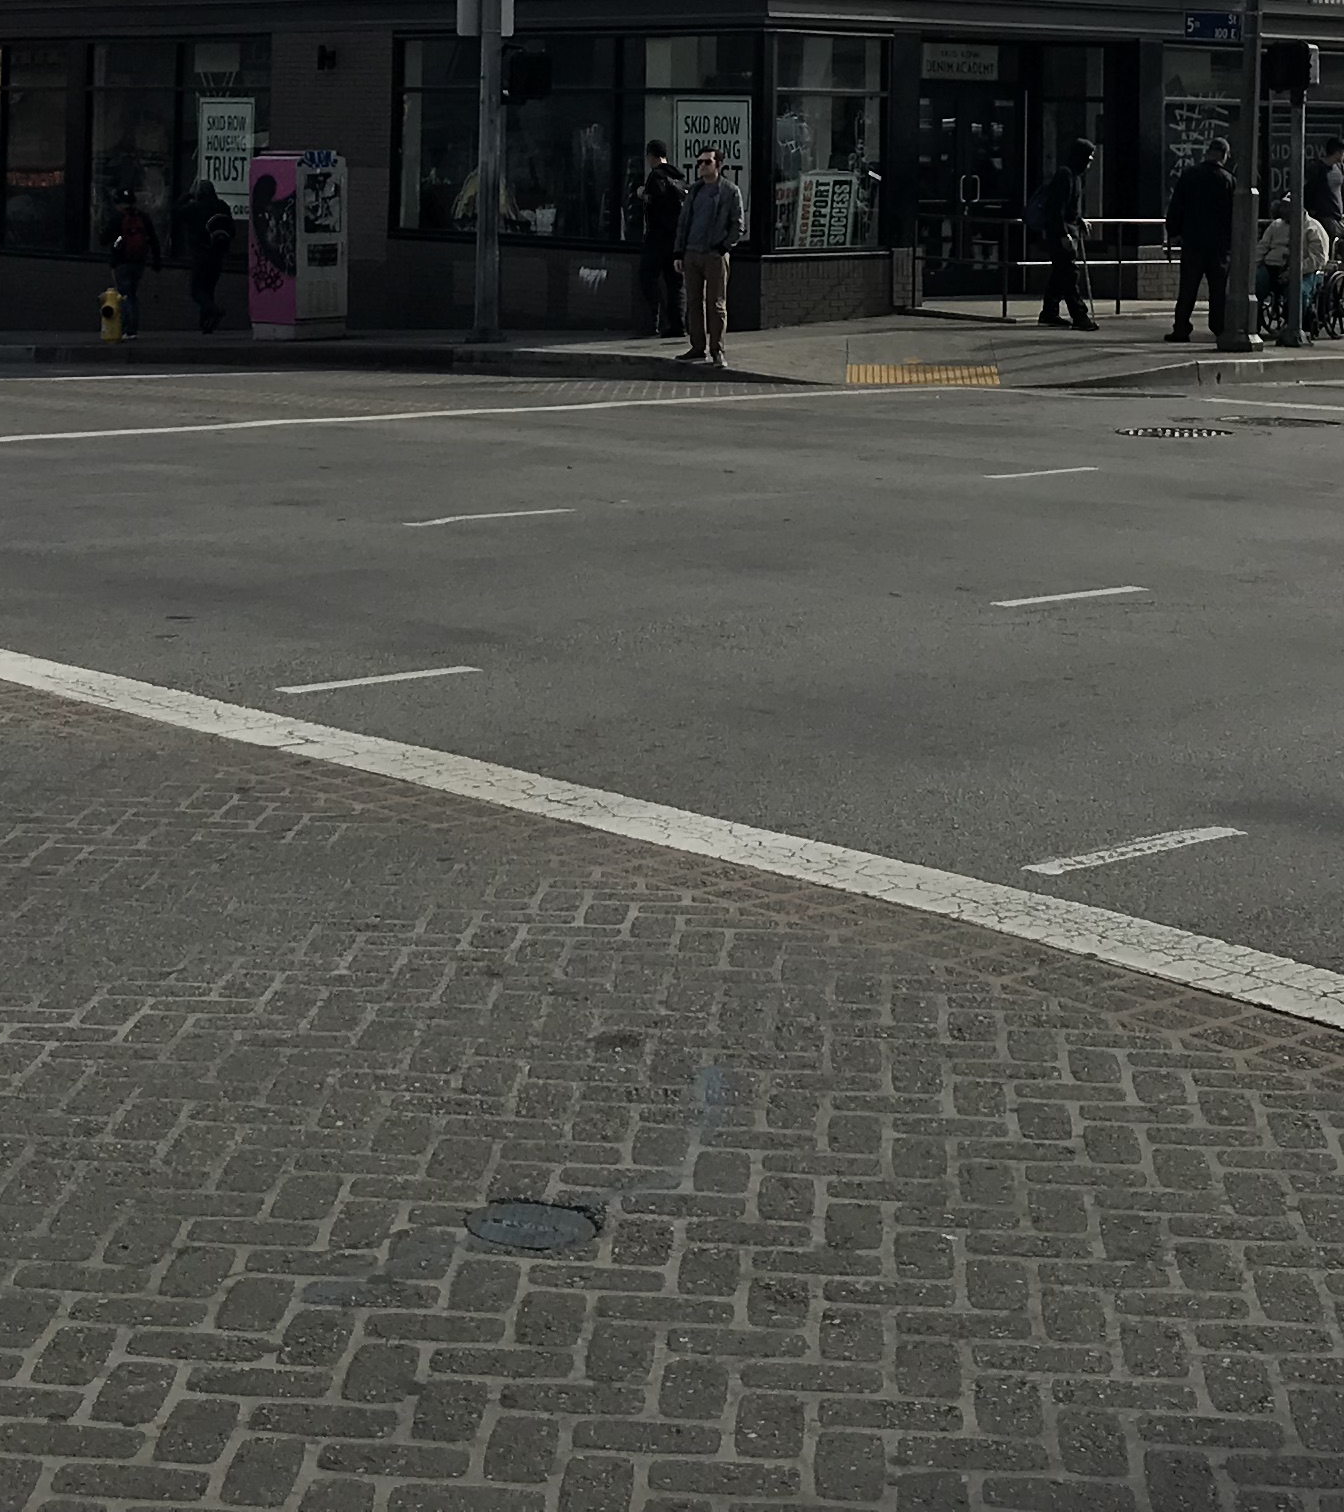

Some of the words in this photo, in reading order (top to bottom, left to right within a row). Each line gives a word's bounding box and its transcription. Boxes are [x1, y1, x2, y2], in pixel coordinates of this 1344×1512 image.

[1228, 14, 1236, 24] St
[207, 115, 225, 130] SKID
[227, 116, 246, 131] ROW
[684, 115, 710, 134] SKID
[714, 116, 740, 134] ROW
[206, 135, 246, 152] HOUSING
[205, 155, 247, 182] TRUST
[682, 164, 743, 186] TST
[809, 179, 831, 247] SUPPORT
[828, 184, 850, 244] SUCCESS
